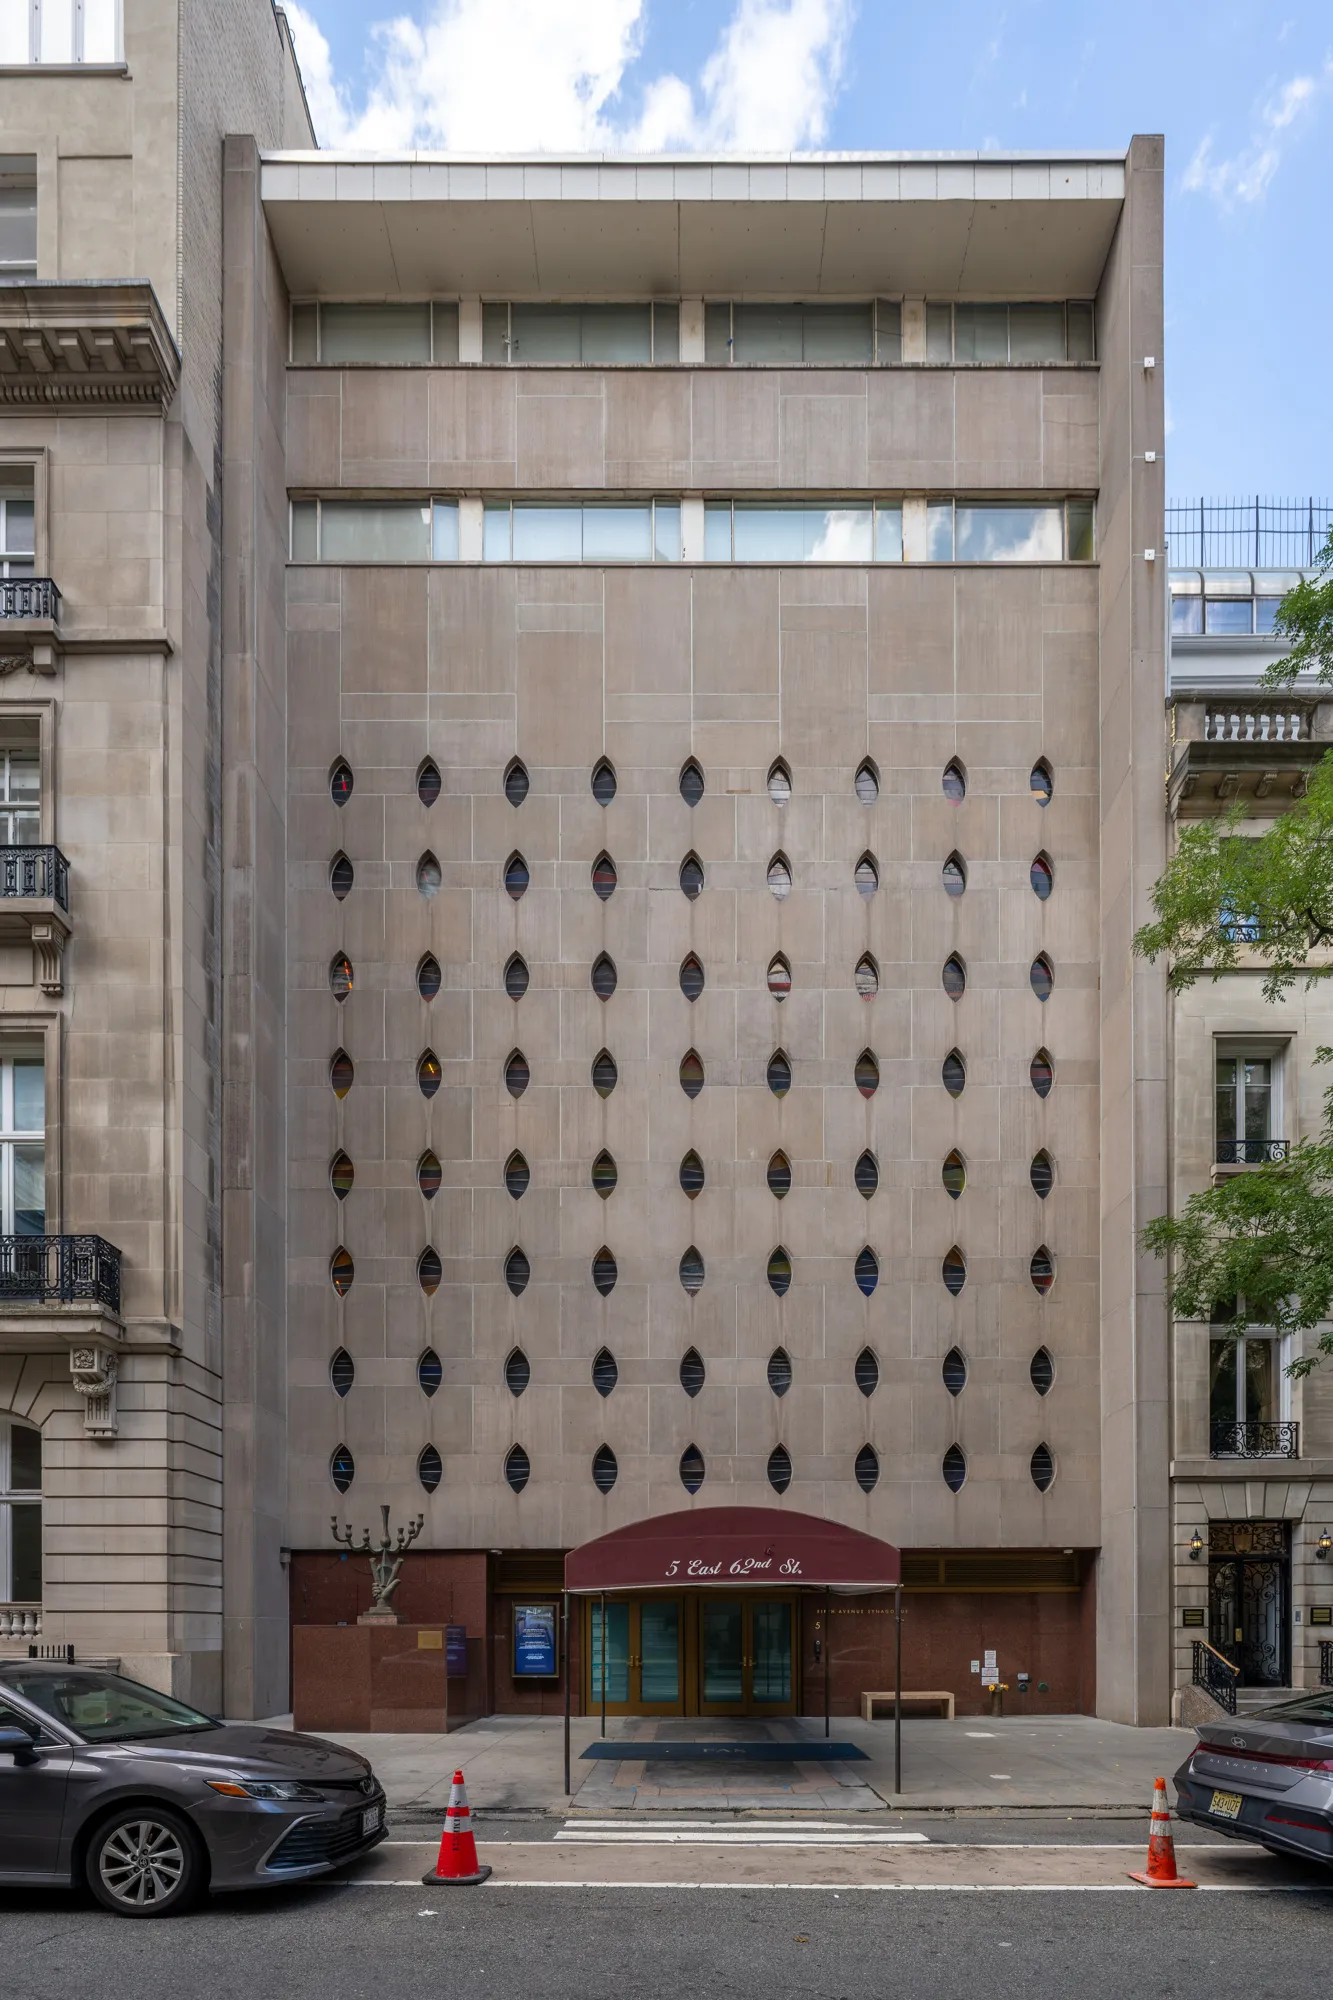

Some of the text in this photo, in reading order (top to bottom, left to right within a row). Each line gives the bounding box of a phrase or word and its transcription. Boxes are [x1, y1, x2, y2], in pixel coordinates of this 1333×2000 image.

[665, 1558, 803, 1576] 5 East 62nd St.
[814, 1621, 821, 1630] 5
